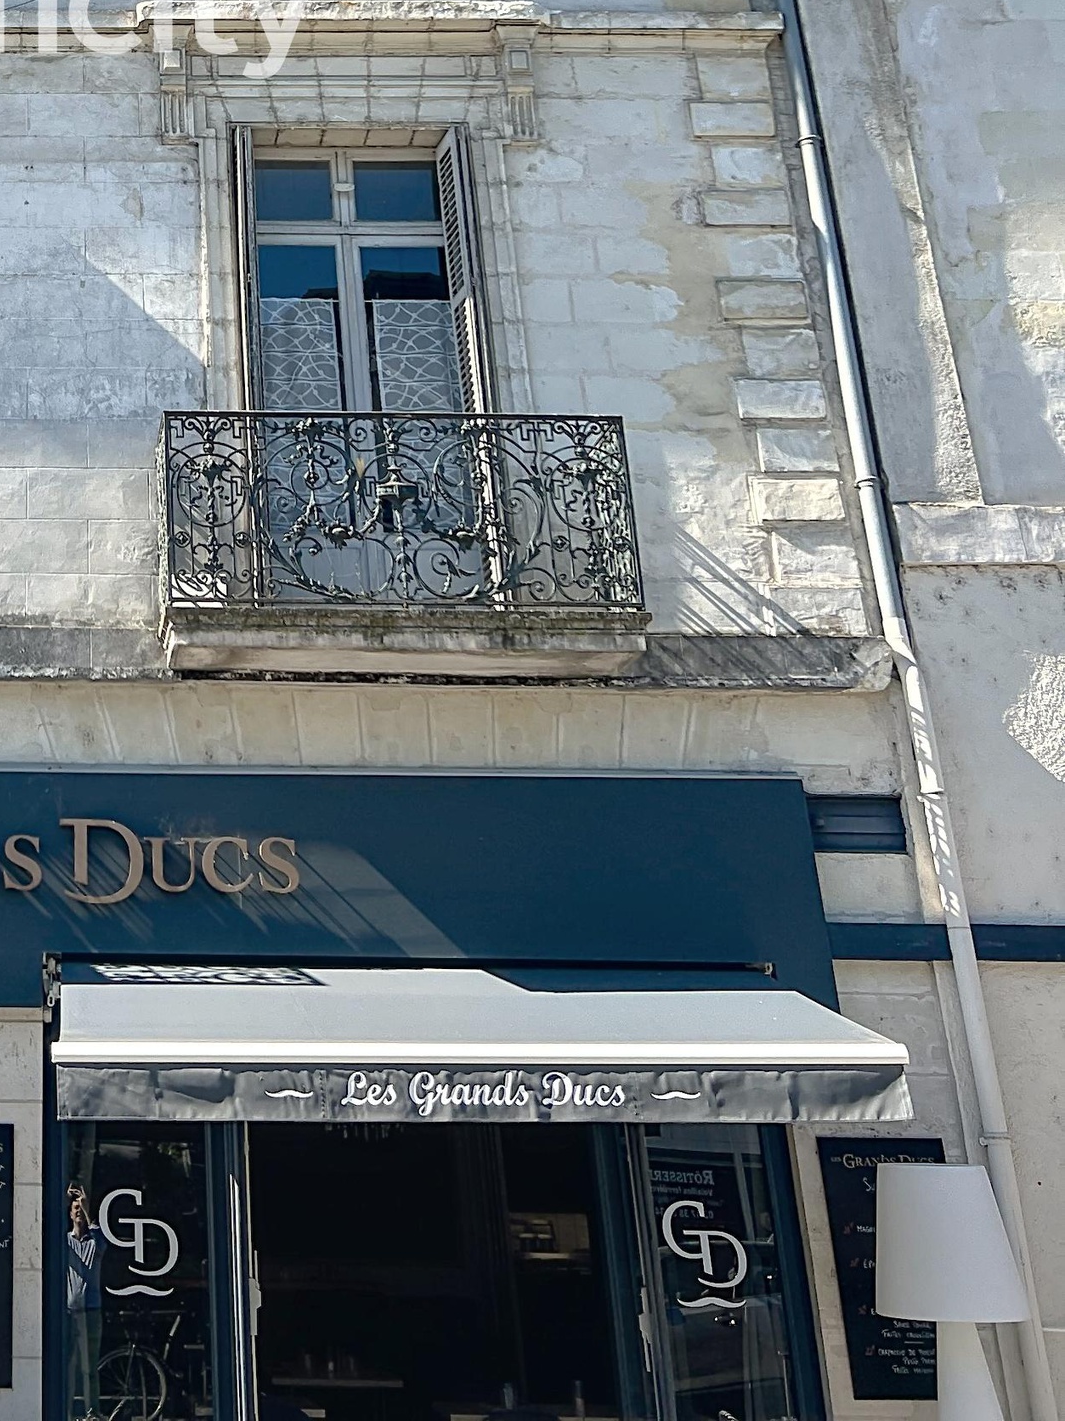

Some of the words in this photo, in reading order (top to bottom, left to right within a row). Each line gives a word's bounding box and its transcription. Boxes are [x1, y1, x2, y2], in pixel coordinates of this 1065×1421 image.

[58, 818, 300, 904] DUCS
[341, 1071, 397, 1106] Les
[408, 1070, 530, 1117] Grands
[541, 1071, 626, 1107] Ducs
[99, 1188, 179, 1277] GD
[661, 1200, 747, 1288] GD
